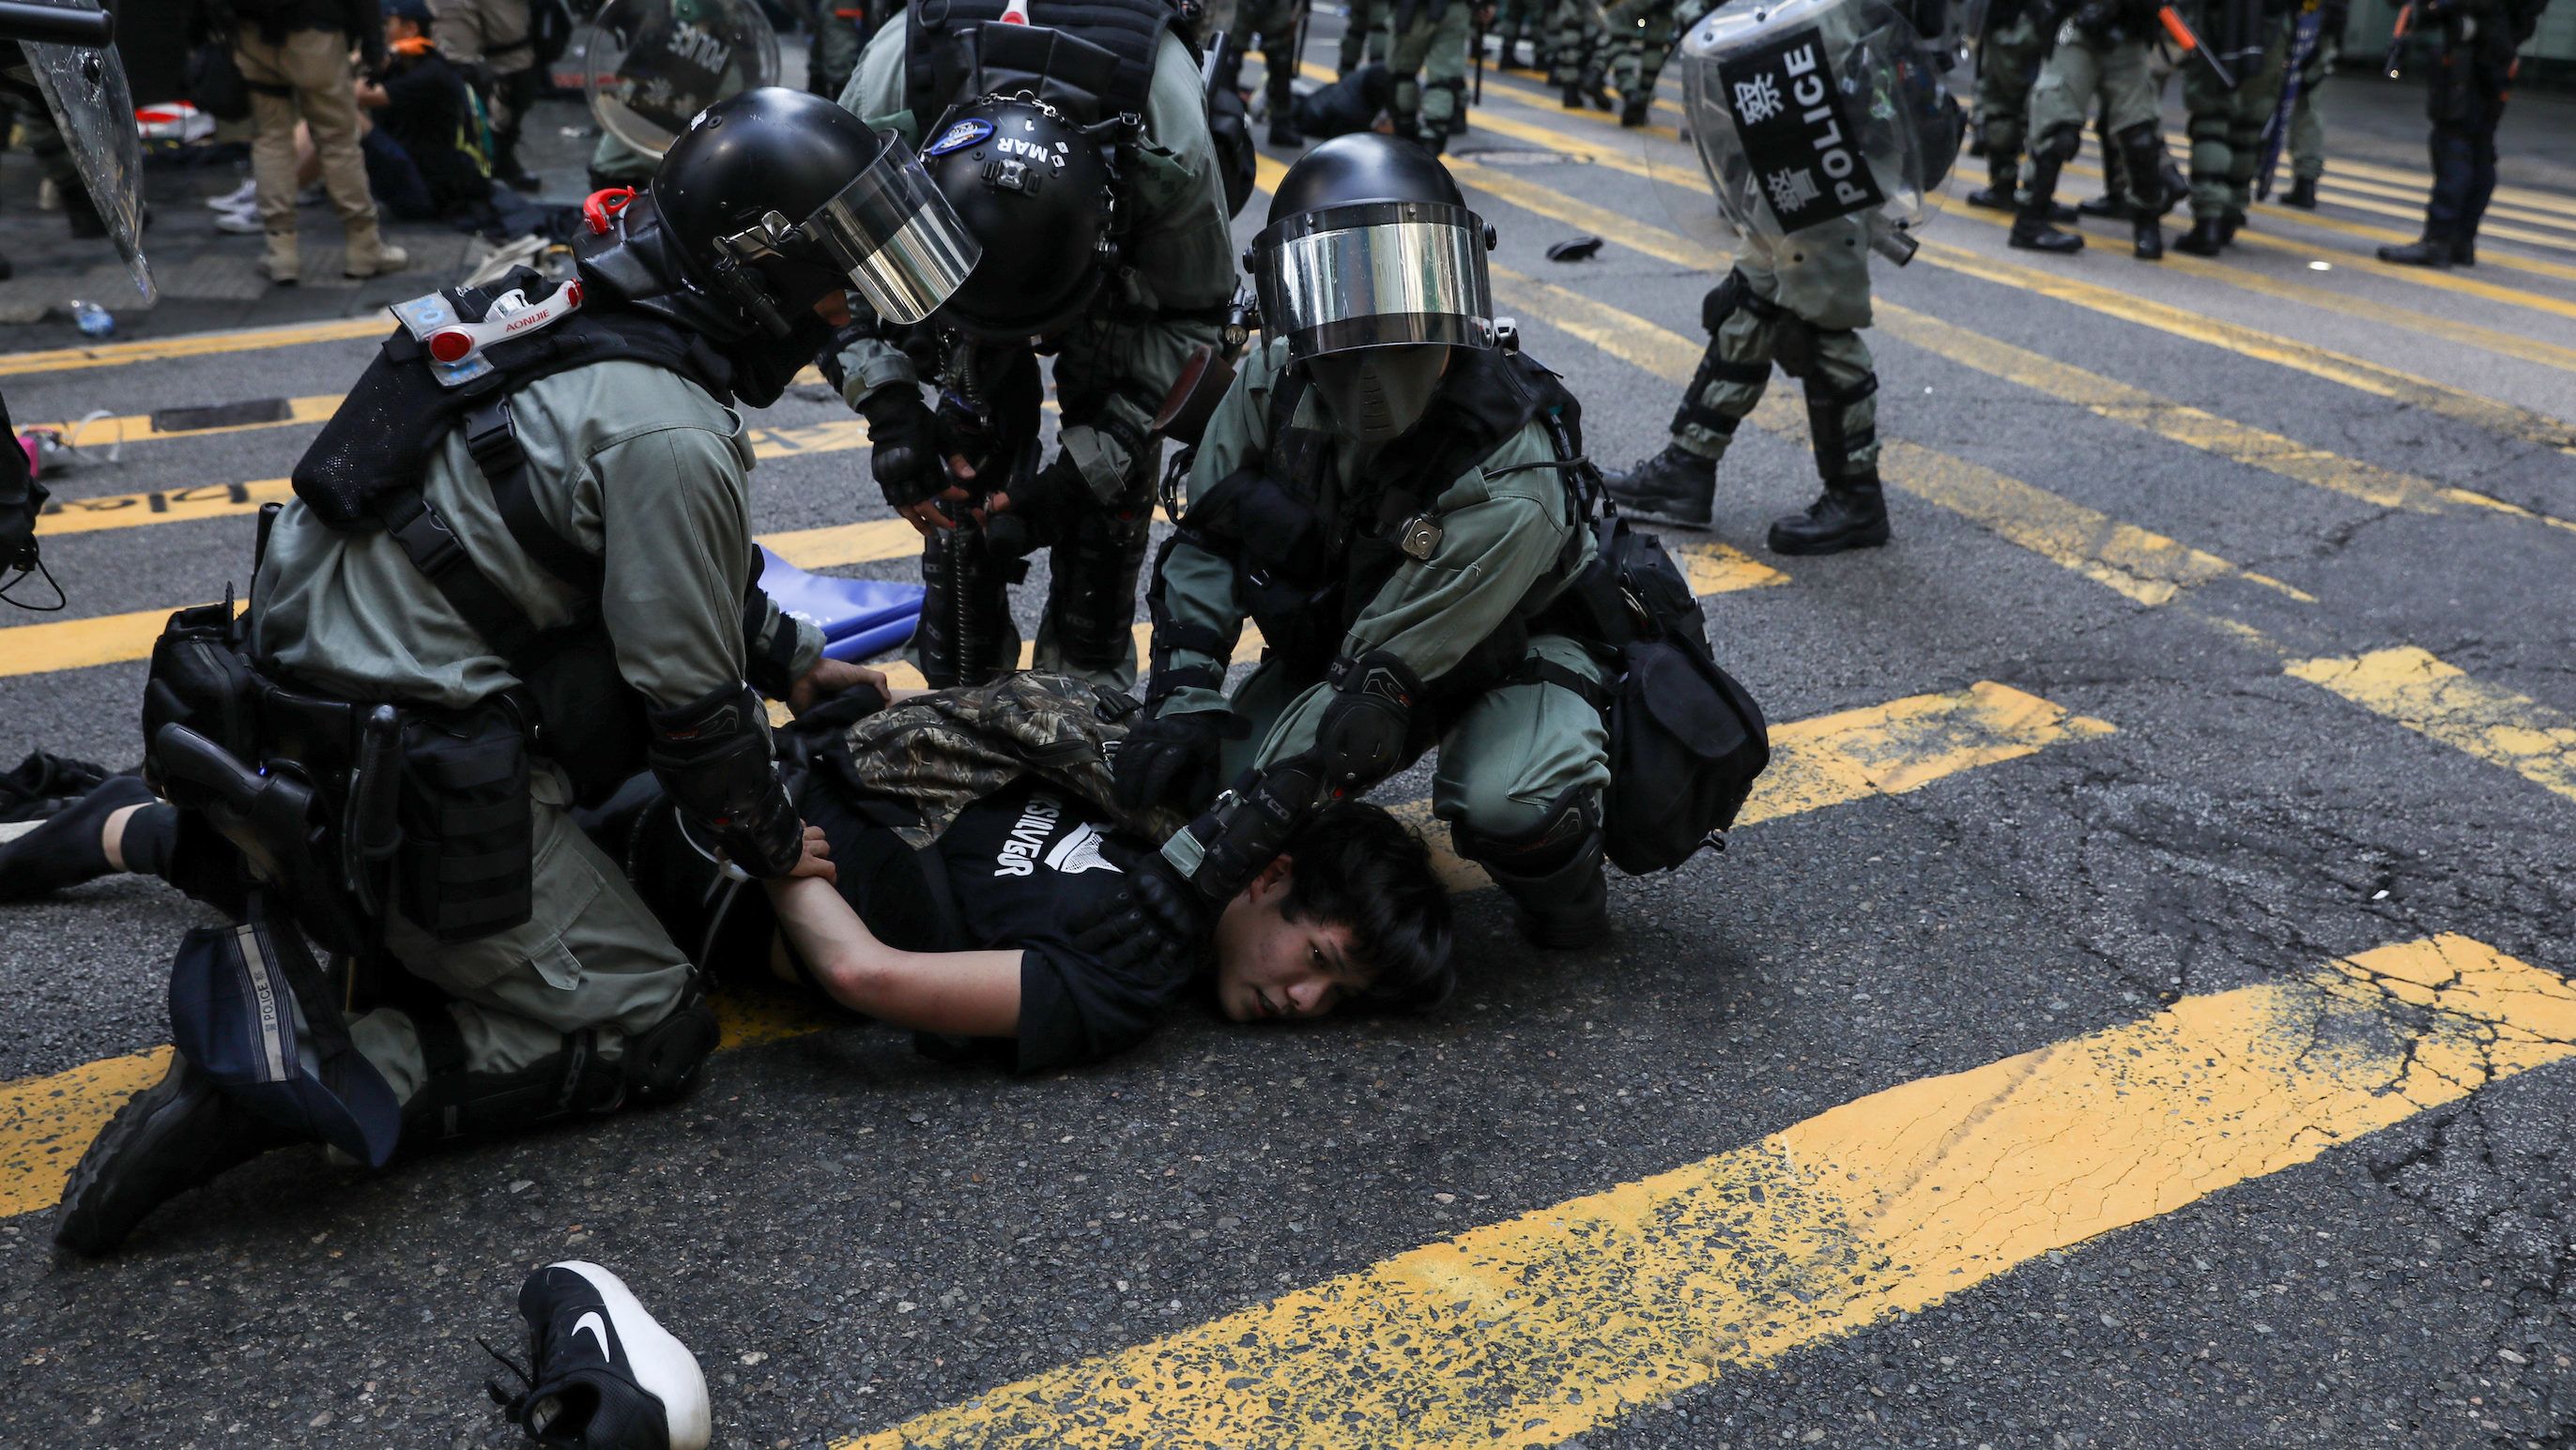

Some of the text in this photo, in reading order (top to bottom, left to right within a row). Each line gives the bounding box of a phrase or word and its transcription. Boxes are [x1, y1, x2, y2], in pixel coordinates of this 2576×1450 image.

[667, 21, 730, 75] POLICE
[1784, 43, 1868, 205] POLICE
[997, 137, 1049, 163] MAR
[506, 309, 550, 332] AONIJIE
[257, 983, 274, 1020] POLICE
